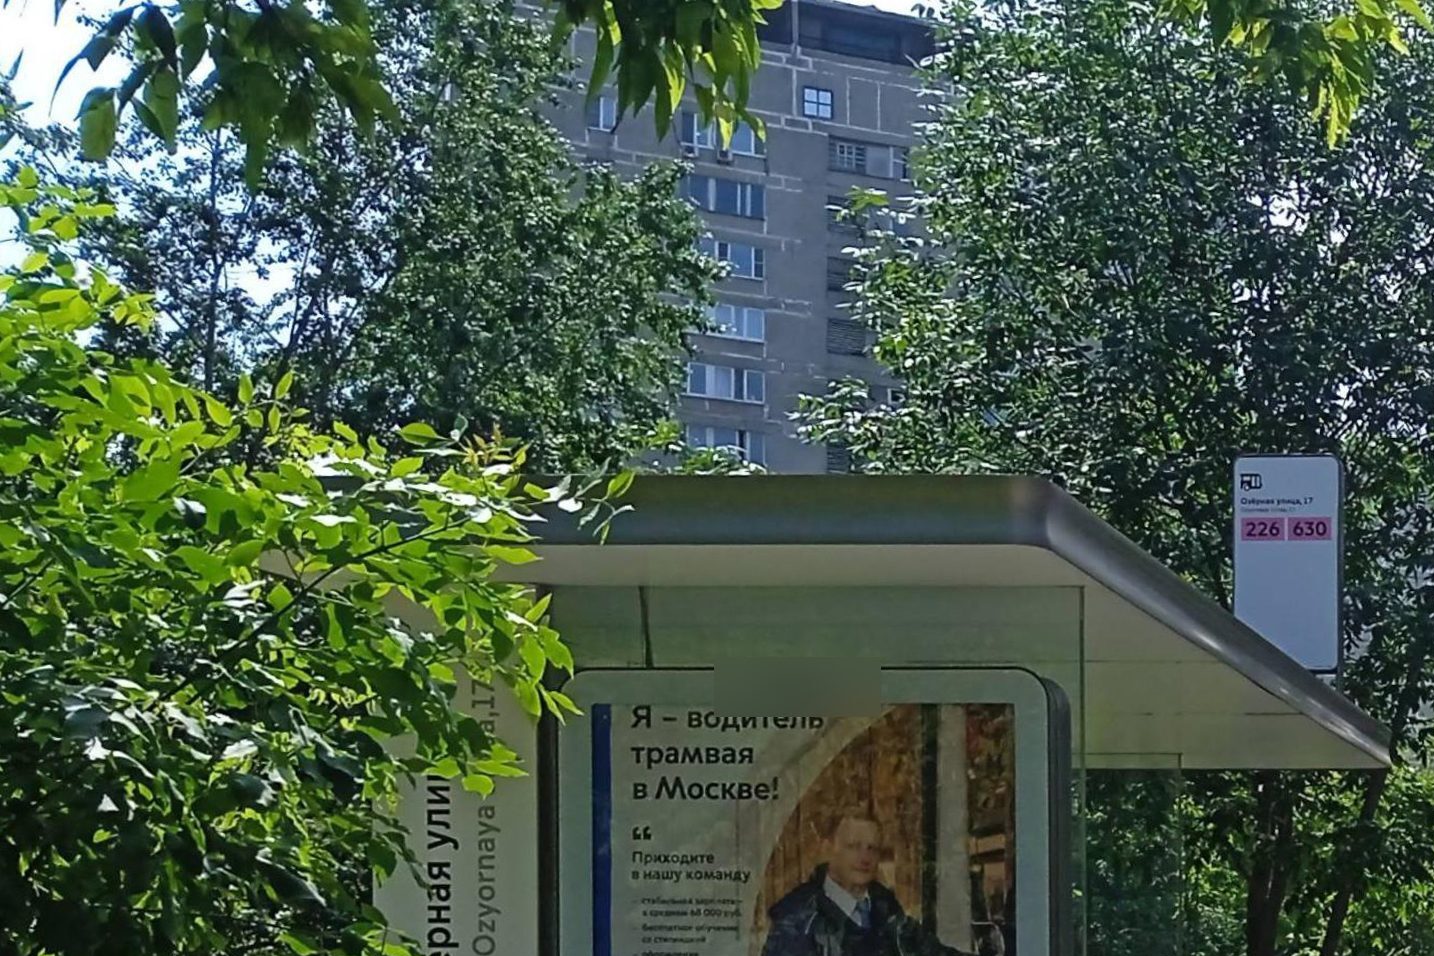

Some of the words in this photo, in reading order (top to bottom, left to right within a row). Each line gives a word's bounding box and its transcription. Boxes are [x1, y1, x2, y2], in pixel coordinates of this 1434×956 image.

[1304, 497, 1313, 505] 17
[1246, 521, 1280, 537] 226
[1293, 521, 1327, 537] 630
[631, 705, 652, 729] Я
[630, 746, 754, 769] трамвая
[633, 782, 648, 800] в
[655, 776, 779, 800] Москве!
[427, 775, 459, 850] ули
[631, 851, 715, 865] Приходите
[472, 805, 502, 956] Ozyornaya
[631, 870, 640, 880] в
[643, 870, 682, 883] нашу
[686, 870, 751, 884] команду
